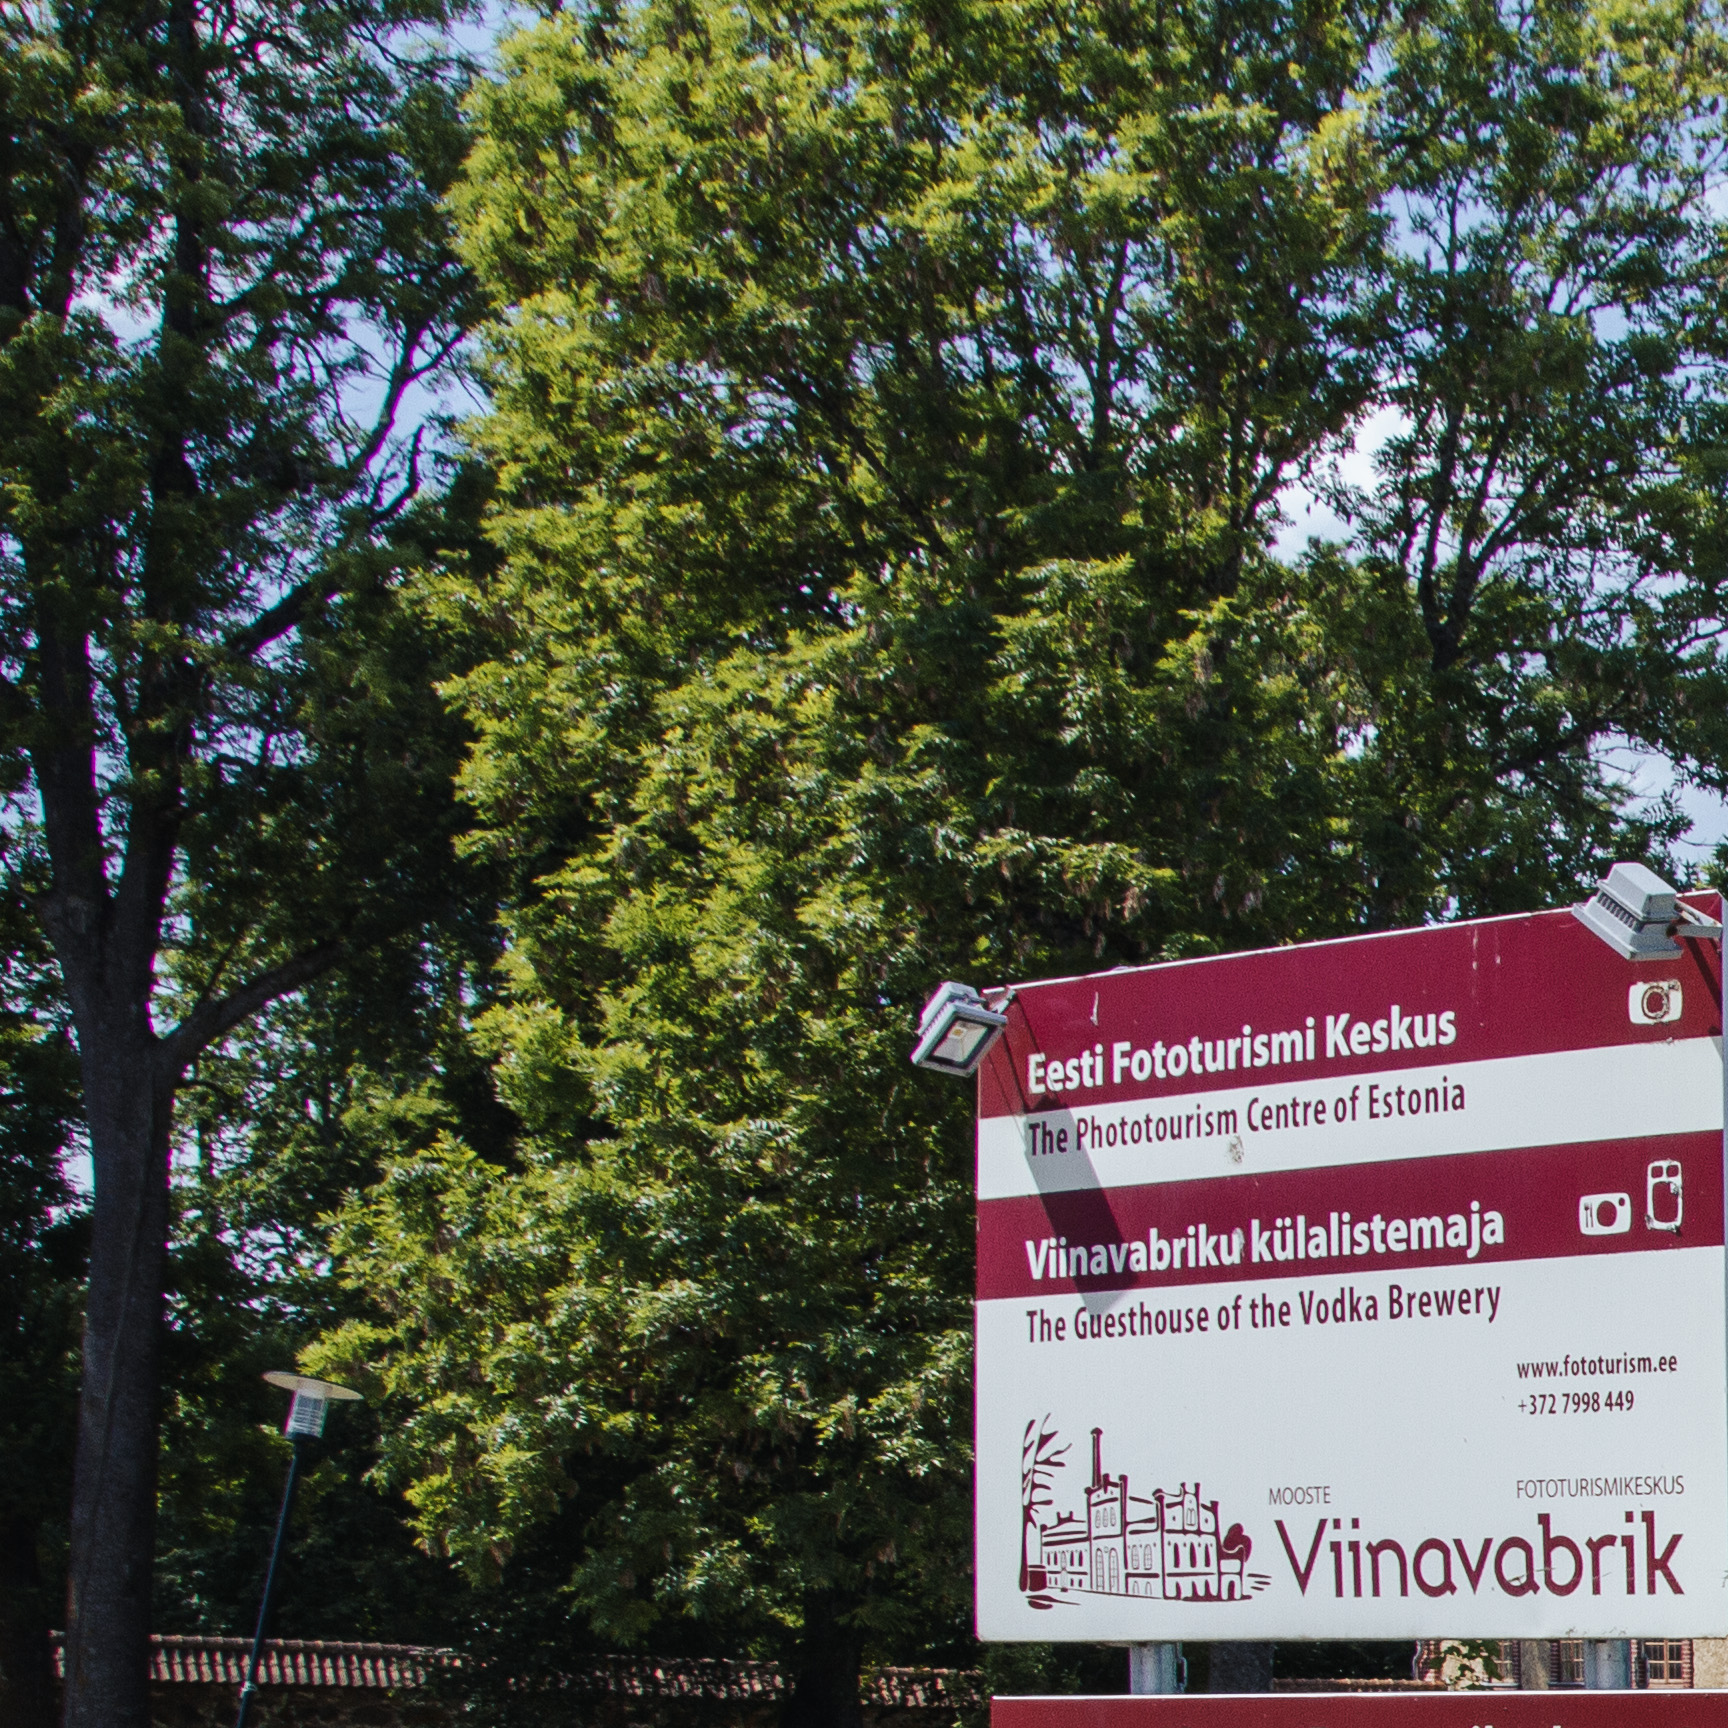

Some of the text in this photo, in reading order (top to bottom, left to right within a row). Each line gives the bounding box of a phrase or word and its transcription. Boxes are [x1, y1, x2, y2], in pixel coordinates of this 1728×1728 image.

[1028, 1005, 1457, 1094] Eesti Fototurismi Keskus
[1029, 1076, 1466, 1156] The Phototourism Centre of Estonia
[1025, 1201, 1505, 1280] Viinavabriku külalistemaja
[1026, 1284, 1501, 1343] The Guesthouse of the Vodka Brewery
[1517, 1352, 1678, 1378] www.fototurism.ee
[1518, 1390, 1635, 1415] +372 7998 449
[1268, 1485, 1332, 1507] MOOSTE
[1516, 1475, 1686, 1500] FOTOTURISMIKESKUS
[1274, 1510, 1686, 1598] Viinavabrik
